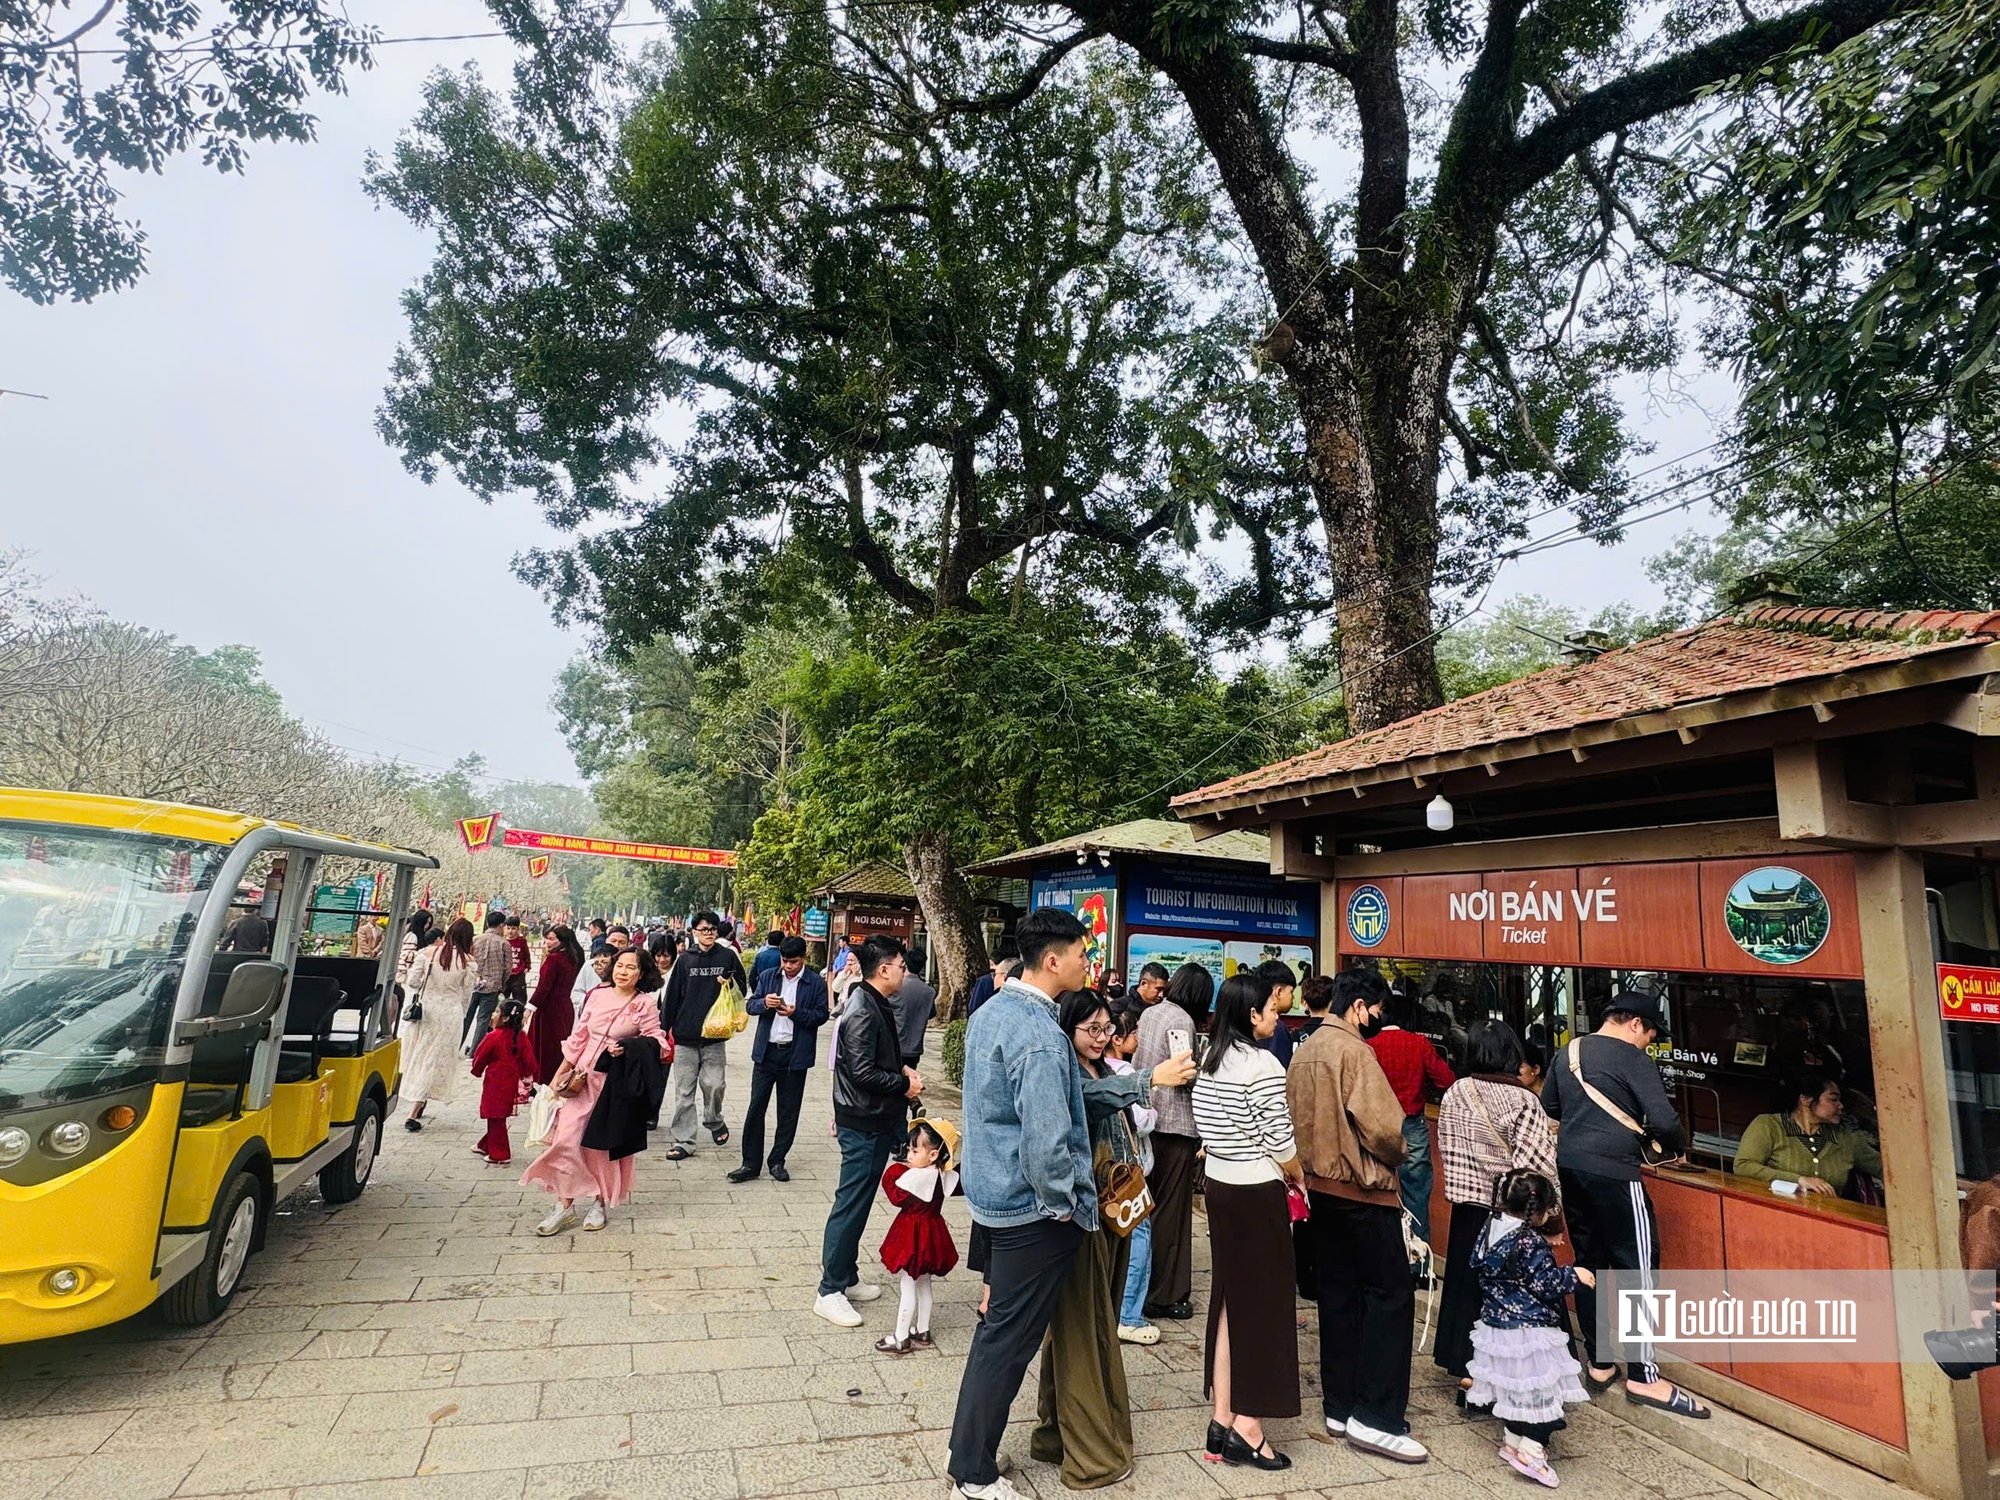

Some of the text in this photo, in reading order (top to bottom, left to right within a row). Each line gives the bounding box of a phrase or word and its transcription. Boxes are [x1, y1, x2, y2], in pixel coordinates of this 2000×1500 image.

[1146, 888, 1298, 917] TOURIST INFORMATION KIOSK
[1450, 877, 1618, 922] NƠI BÁN VÉ
[854, 915, 869, 924] NƠI
[870, 915, 891, 926] SOÁT
[1501, 926, 1547, 944] Ticket
[1970, 1002, 2000, 1014] NO FIRE
[1673, 1048, 1698, 1063] Bán
[1700, 1051, 1718, 1065] Vé
[1686, 1069, 1706, 1081] Shop
